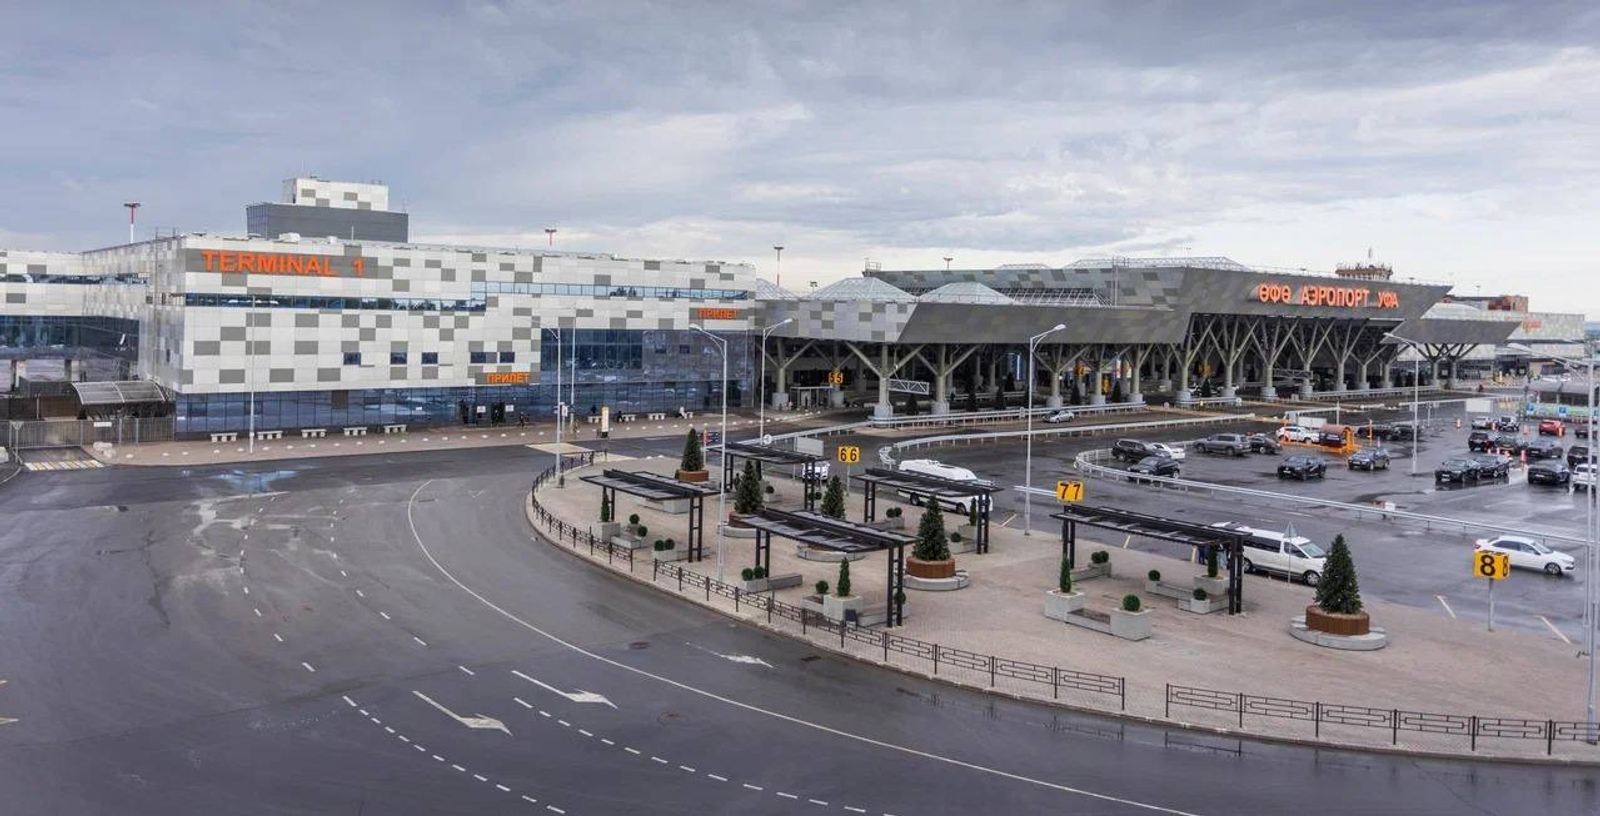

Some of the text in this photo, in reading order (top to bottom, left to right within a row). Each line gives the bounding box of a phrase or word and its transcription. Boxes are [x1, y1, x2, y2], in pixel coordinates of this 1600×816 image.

[201, 250, 364, 277] TERMINAL 1
[1301, 285, 1370, 307] АЭРОПОРТ
[1377, 291, 1399, 308] УФА
[486, 372, 530, 384] ПРИЛЕТ
[1480, 554, 1496, 577] 8
